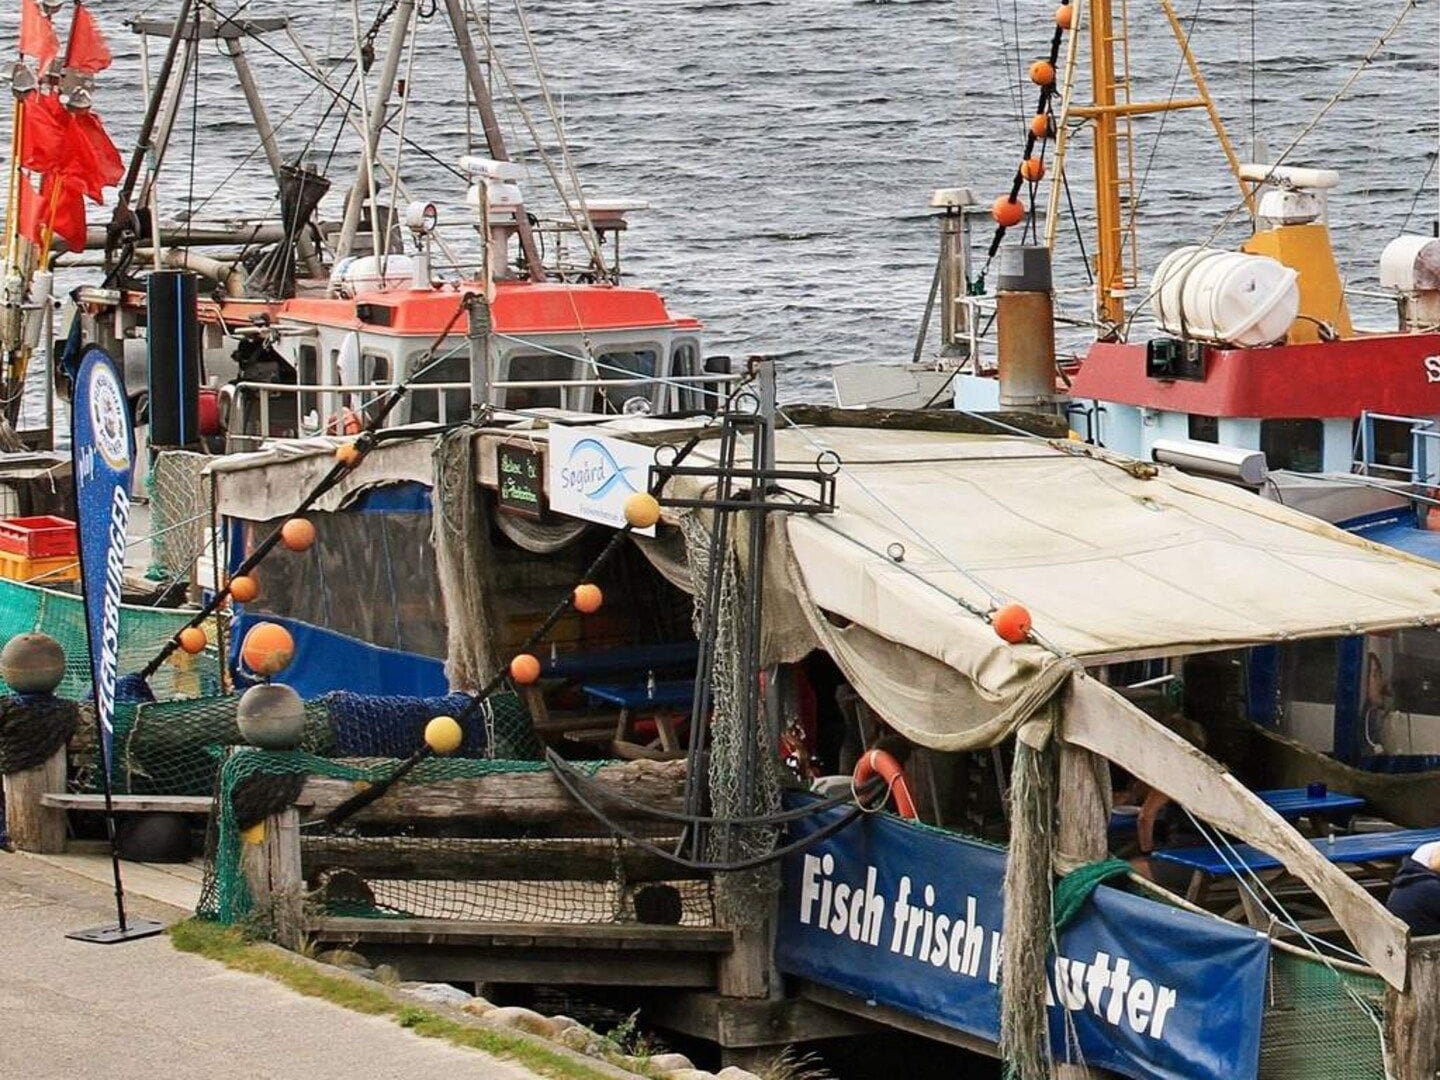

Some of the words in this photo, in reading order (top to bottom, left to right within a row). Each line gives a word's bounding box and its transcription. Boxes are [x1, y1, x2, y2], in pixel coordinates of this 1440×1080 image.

[100, 485, 130, 733] FLENSBURGER
[800, 853, 886, 946] Fisch
[890, 875, 984, 978] frisch
[1046, 951, 1176, 1039] utter
